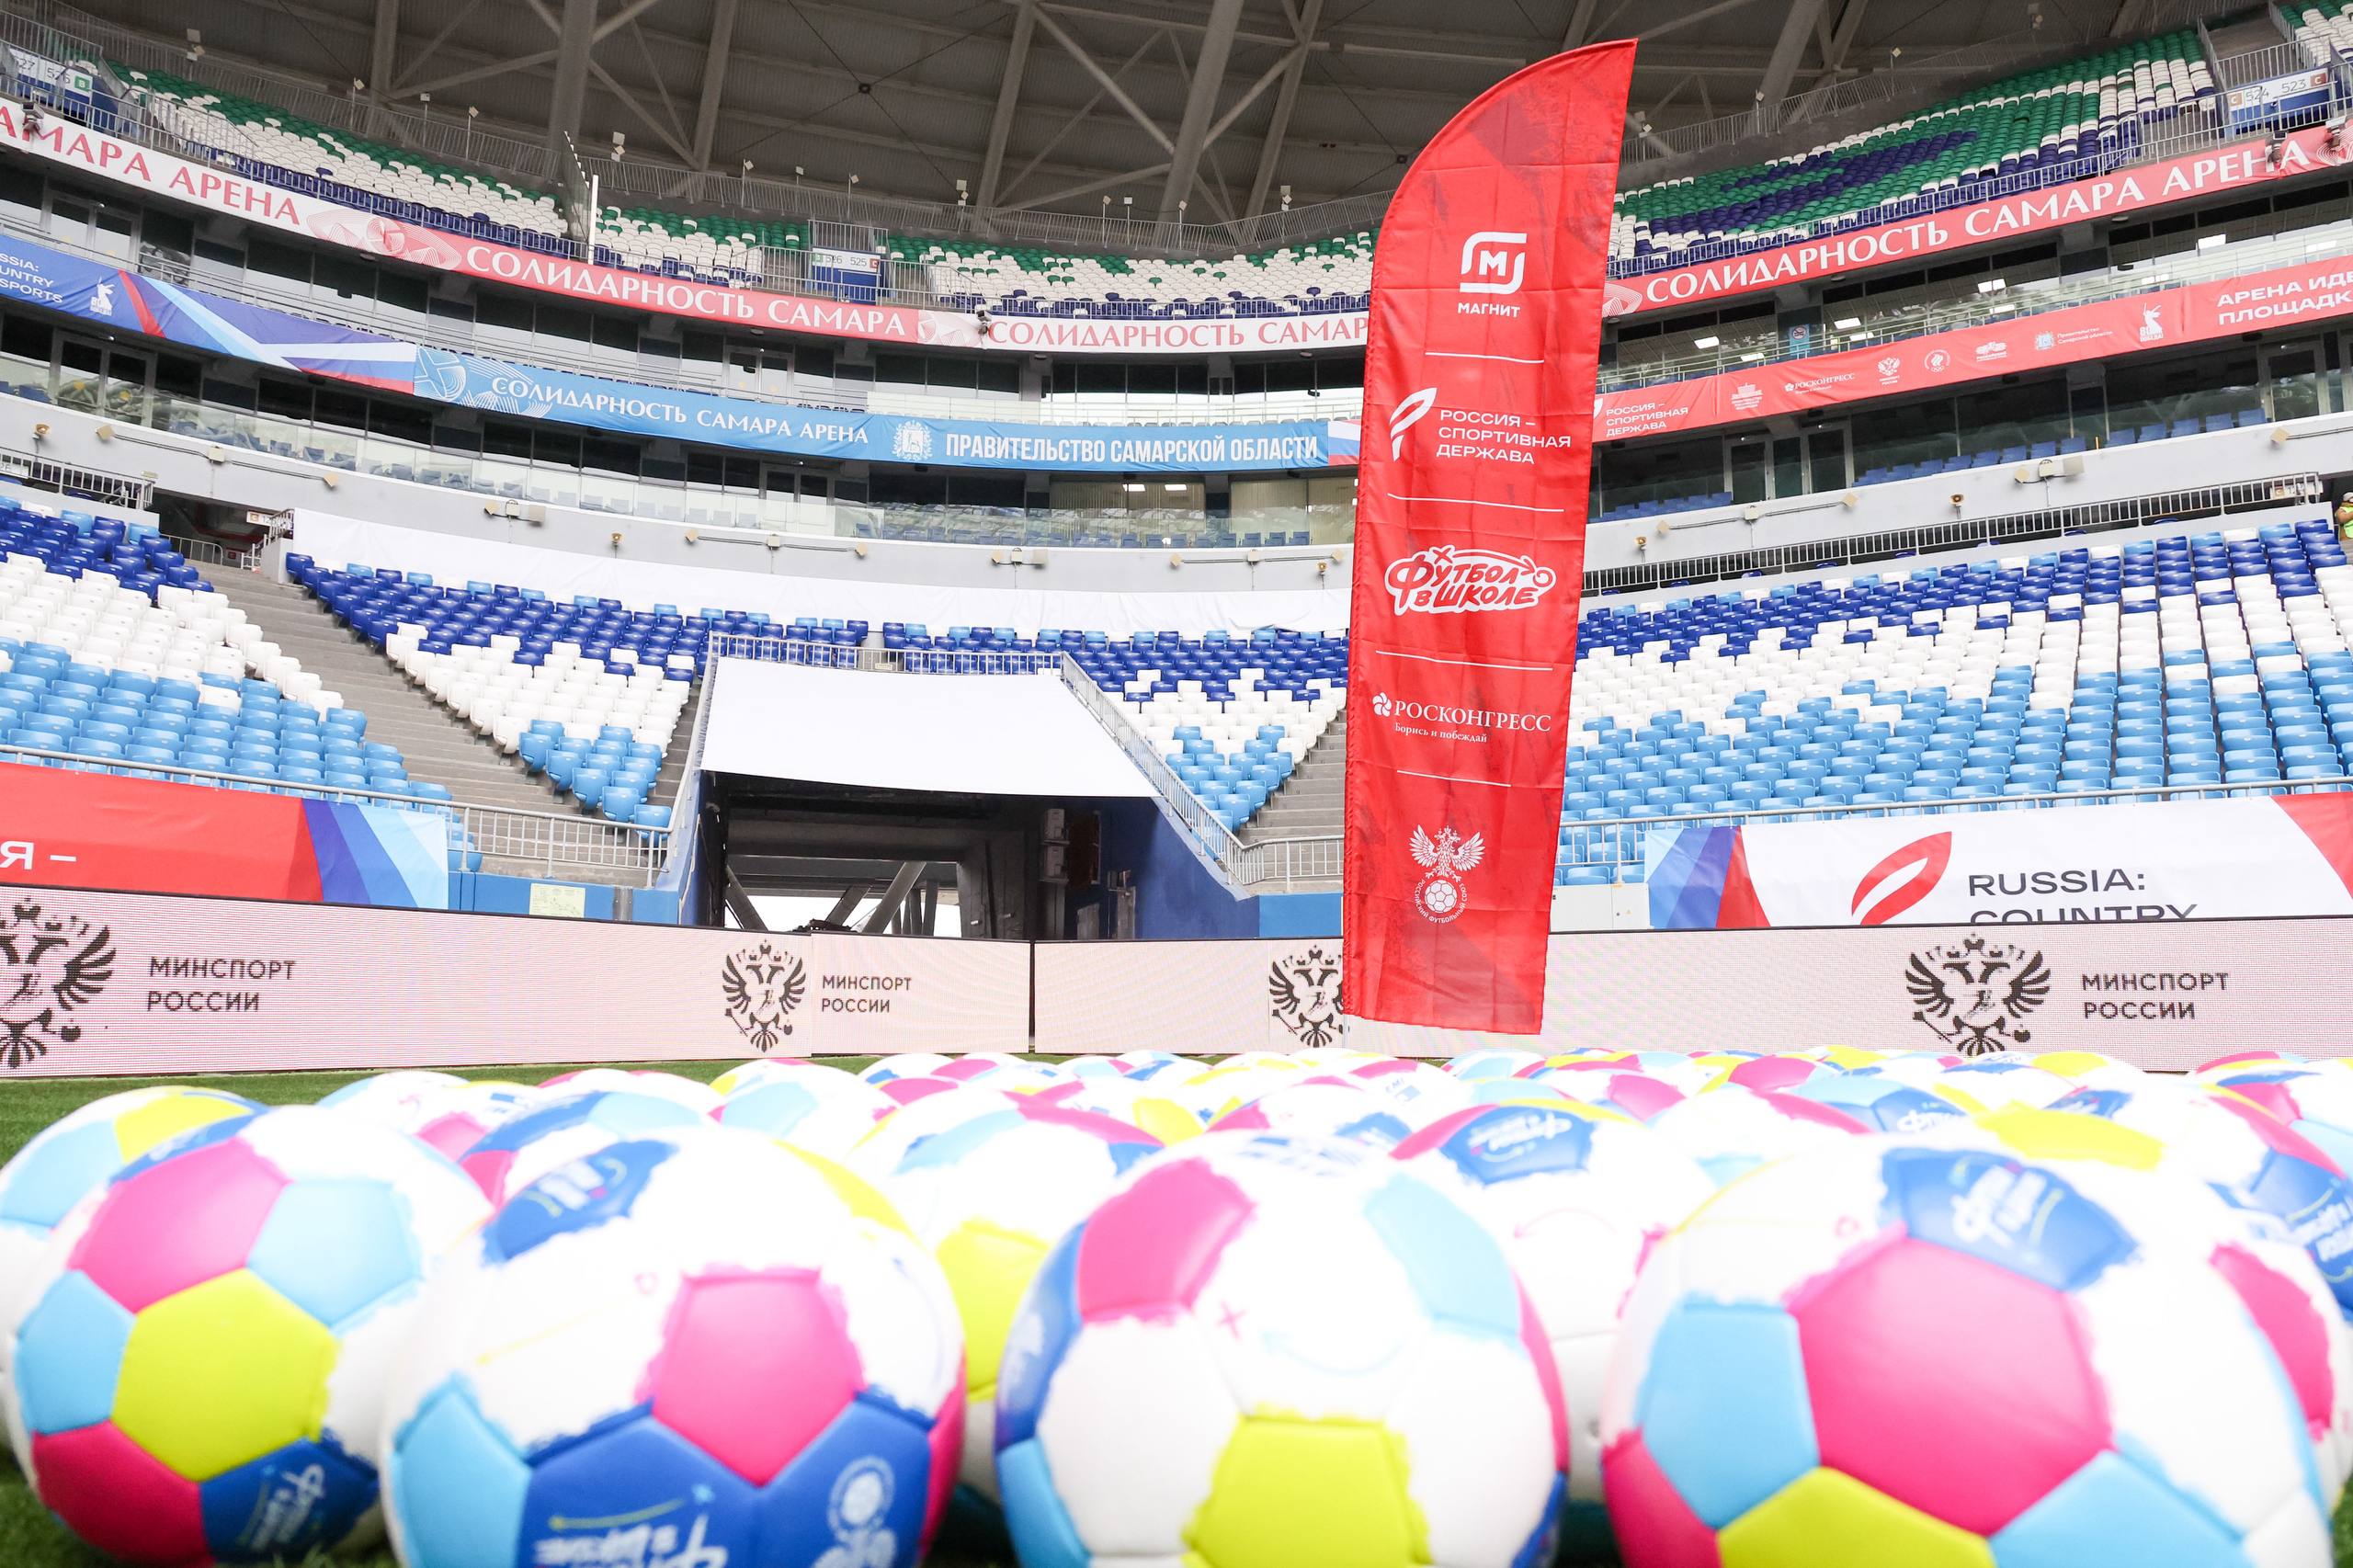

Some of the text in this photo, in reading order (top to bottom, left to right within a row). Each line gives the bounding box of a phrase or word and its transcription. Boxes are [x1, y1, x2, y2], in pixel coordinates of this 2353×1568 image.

[2281, 79, 2306, 92] 523
[169, 165, 300, 225] АРЕНА
[1646, 141, 2310, 302] СОЛИДАРНОСТЬ САМАРА АРЕНА
[0, 278, 63, 303] SPORTS
[467, 245, 904, 336] СОЛИДАРНОСТЬ САМАРА
[2217, 281, 2302, 308] АРЕНА
[1458, 302, 1520, 317] МАГНИТ
[2219, 290, 2353, 325] ПЛОЩАДК
[988, 321, 1244, 347] СОЛИДАРНОСТЬ
[493, 378, 868, 443] СОЛИДАРНОСТЬ САМАРА АРЕНА
[1440, 410, 1520, 427] РОССИЯ
[1606, 403, 1654, 416] РОССИЯ
[1606, 407, 1688, 426] СПОРТИВНАЯ
[1438, 427, 1572, 448] СПОРТИВНАЯ
[1606, 421, 1666, 437] ДЕРЖАВА
[946, 434, 1317, 462] ПРАВИТЕЛЬСТВО САМАРСКОЙ ОБЛАСТИ
[1436, 444, 1535, 464] ДЕРЖАВА
[1394, 700, 1552, 732] РОСКОНГРЕСС
[1395, 722, 1428, 737] Борись
[1440, 731, 1487, 743] побеждай
[1969, 868, 2145, 897] RUSSIA:
[149, 956, 296, 980] МИНСПОРТ
[823, 975, 912, 991] МИНСПОРТ
[2081, 971, 2229, 992] МИНСПОРТ
[147, 991, 259, 1012] РОССИИ
[822, 998, 891, 1013] РОССИИ
[2084, 1002, 2195, 1019] РОССИИ
